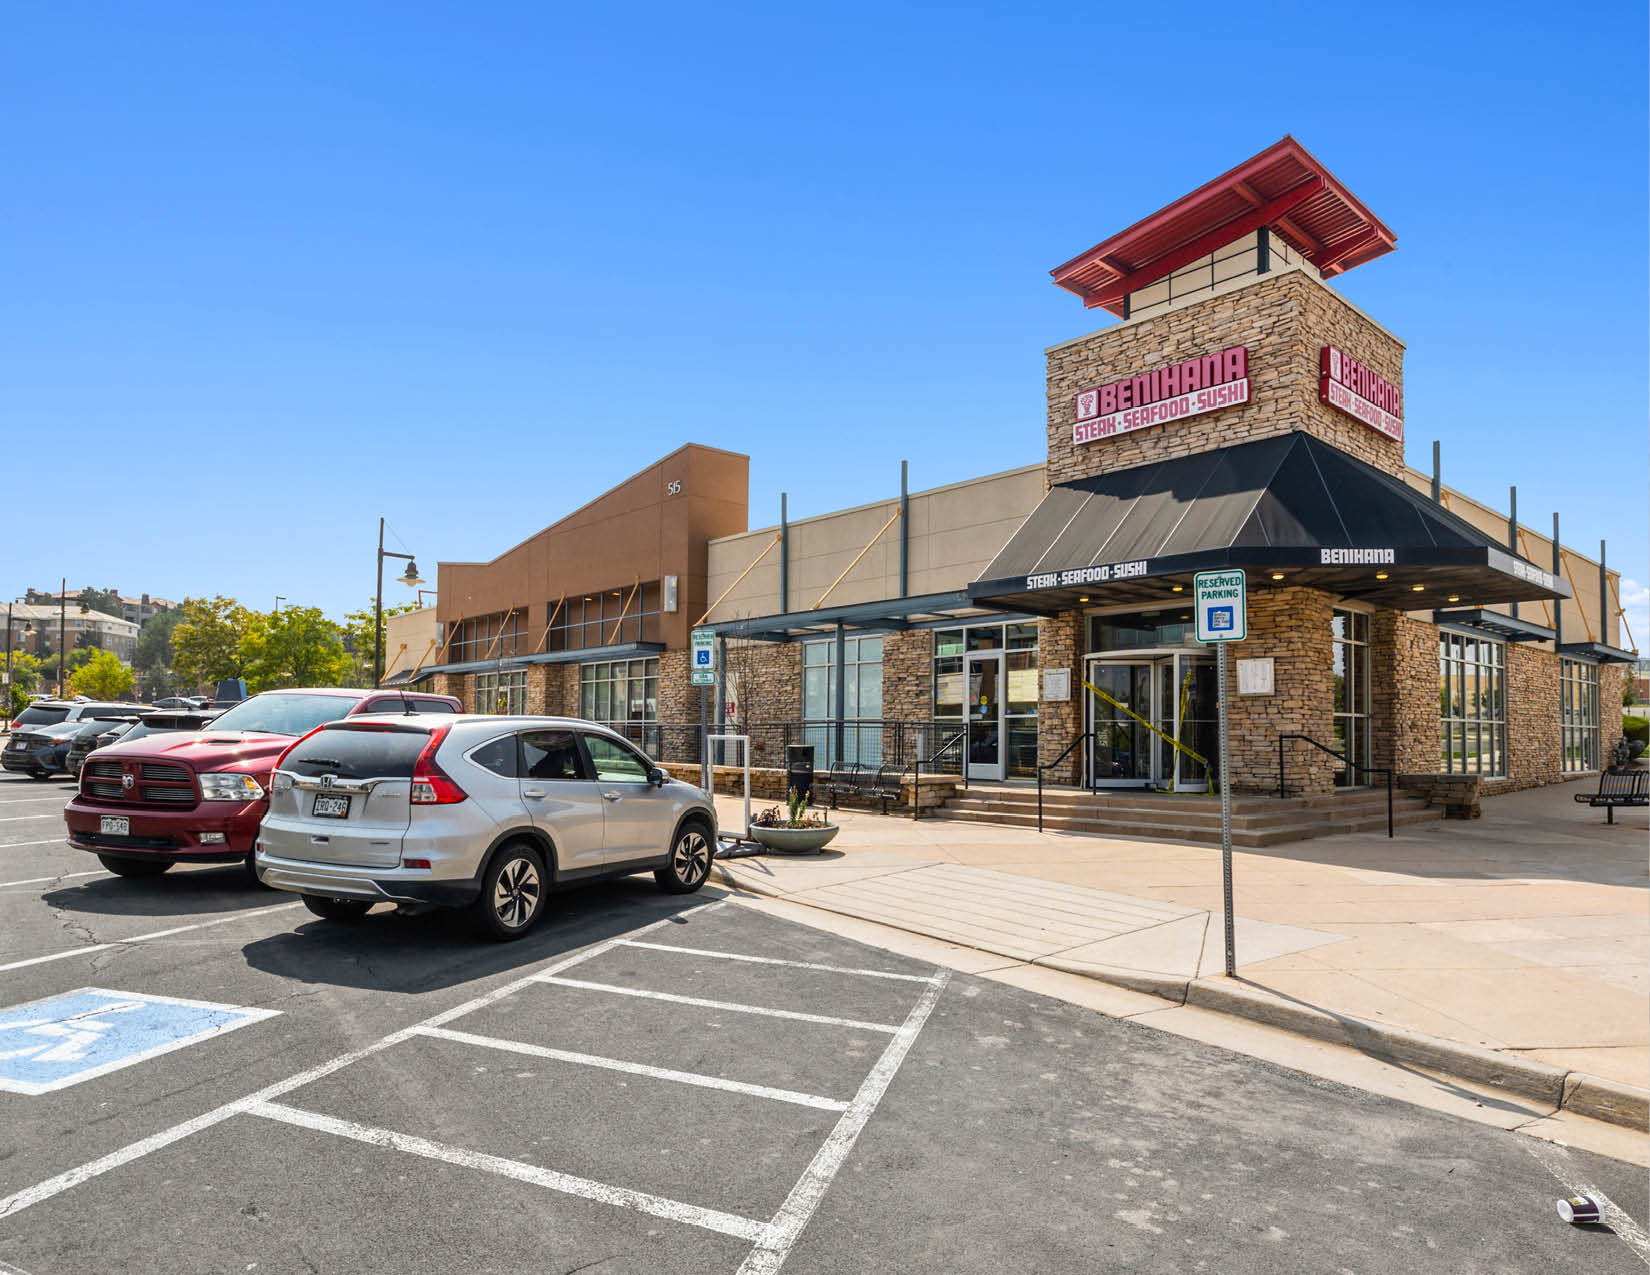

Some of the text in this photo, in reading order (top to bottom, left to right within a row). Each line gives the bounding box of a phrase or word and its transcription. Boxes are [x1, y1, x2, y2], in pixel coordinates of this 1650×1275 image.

[1101, 346, 1246, 415] BENIHANA
[1342, 353, 1400, 418] BENIHANA
[1075, 381, 1245, 442] STEAK SEAFOOD SUSHI
[1320, 548, 1394, 564] BENIHANA
[1026, 561, 1147, 589] STEAK SEAFOOD SUSHI
[1198, 576, 1241, 589] RESERVED
[1201, 588, 1239, 600] PARKING
